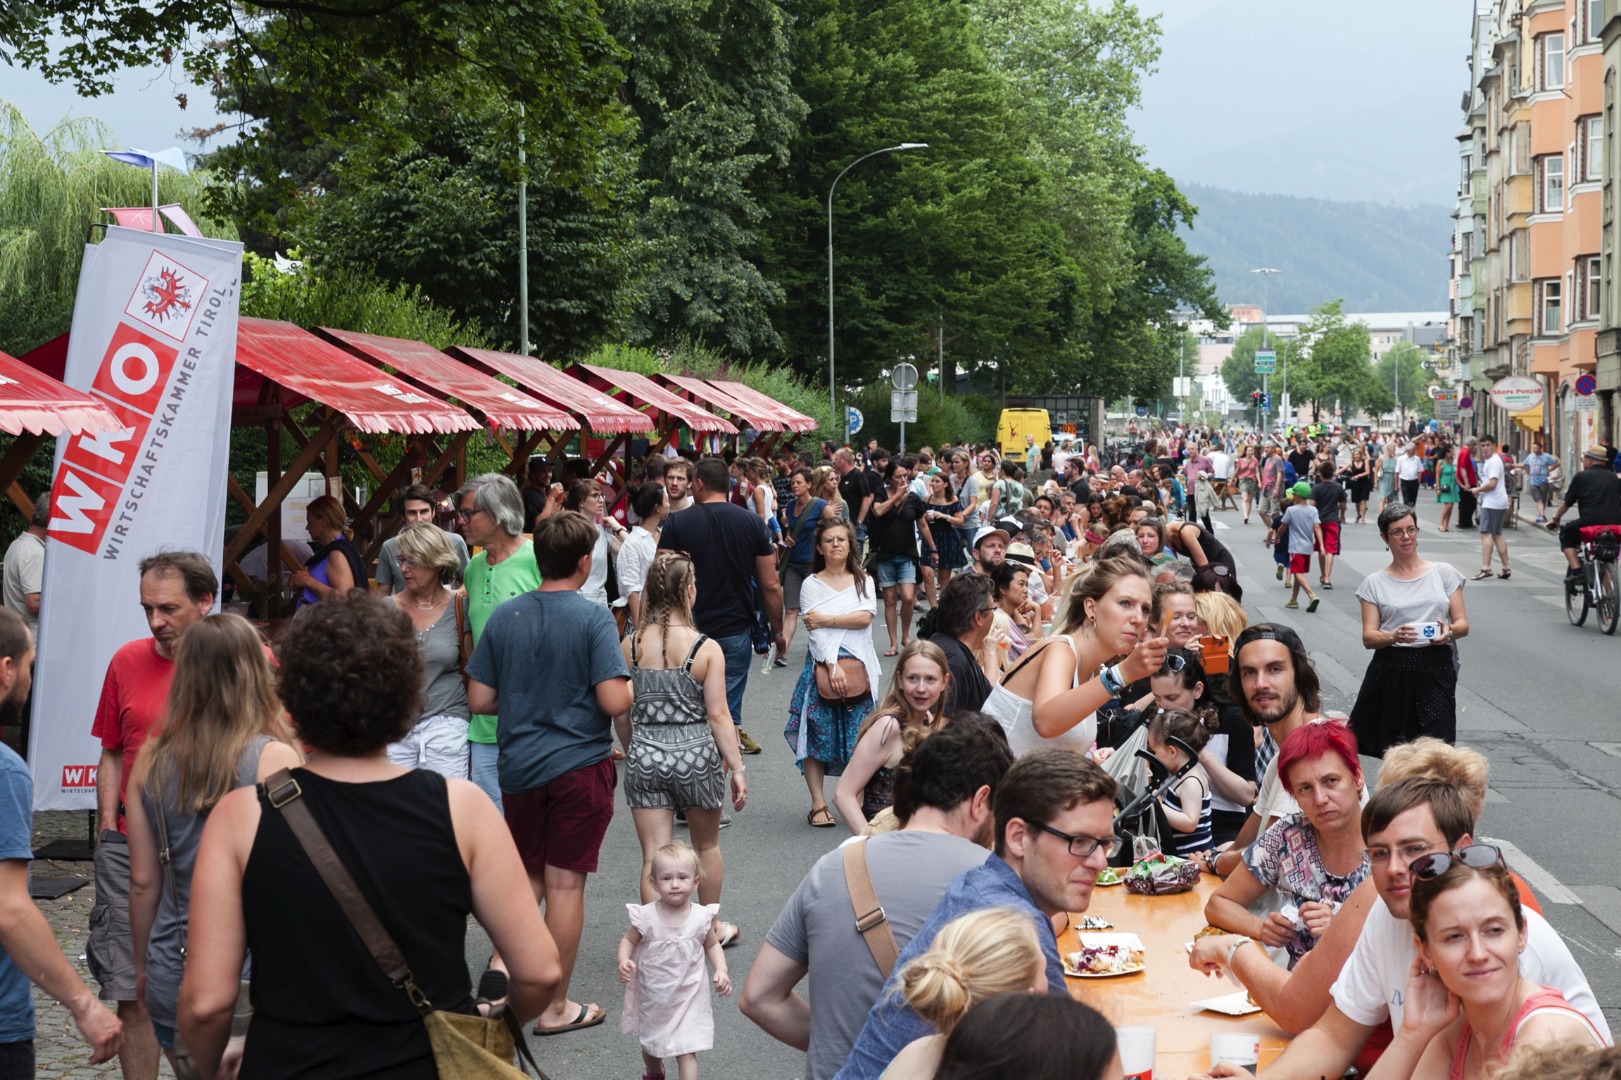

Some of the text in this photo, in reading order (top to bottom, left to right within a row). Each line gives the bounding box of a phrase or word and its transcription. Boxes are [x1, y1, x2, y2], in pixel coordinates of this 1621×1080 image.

[47, 342, 159, 534] WKO
[103, 287, 226, 561] WIRTSCHAFTSKAMMER TIROL
[850, 415, 858, 425] P
